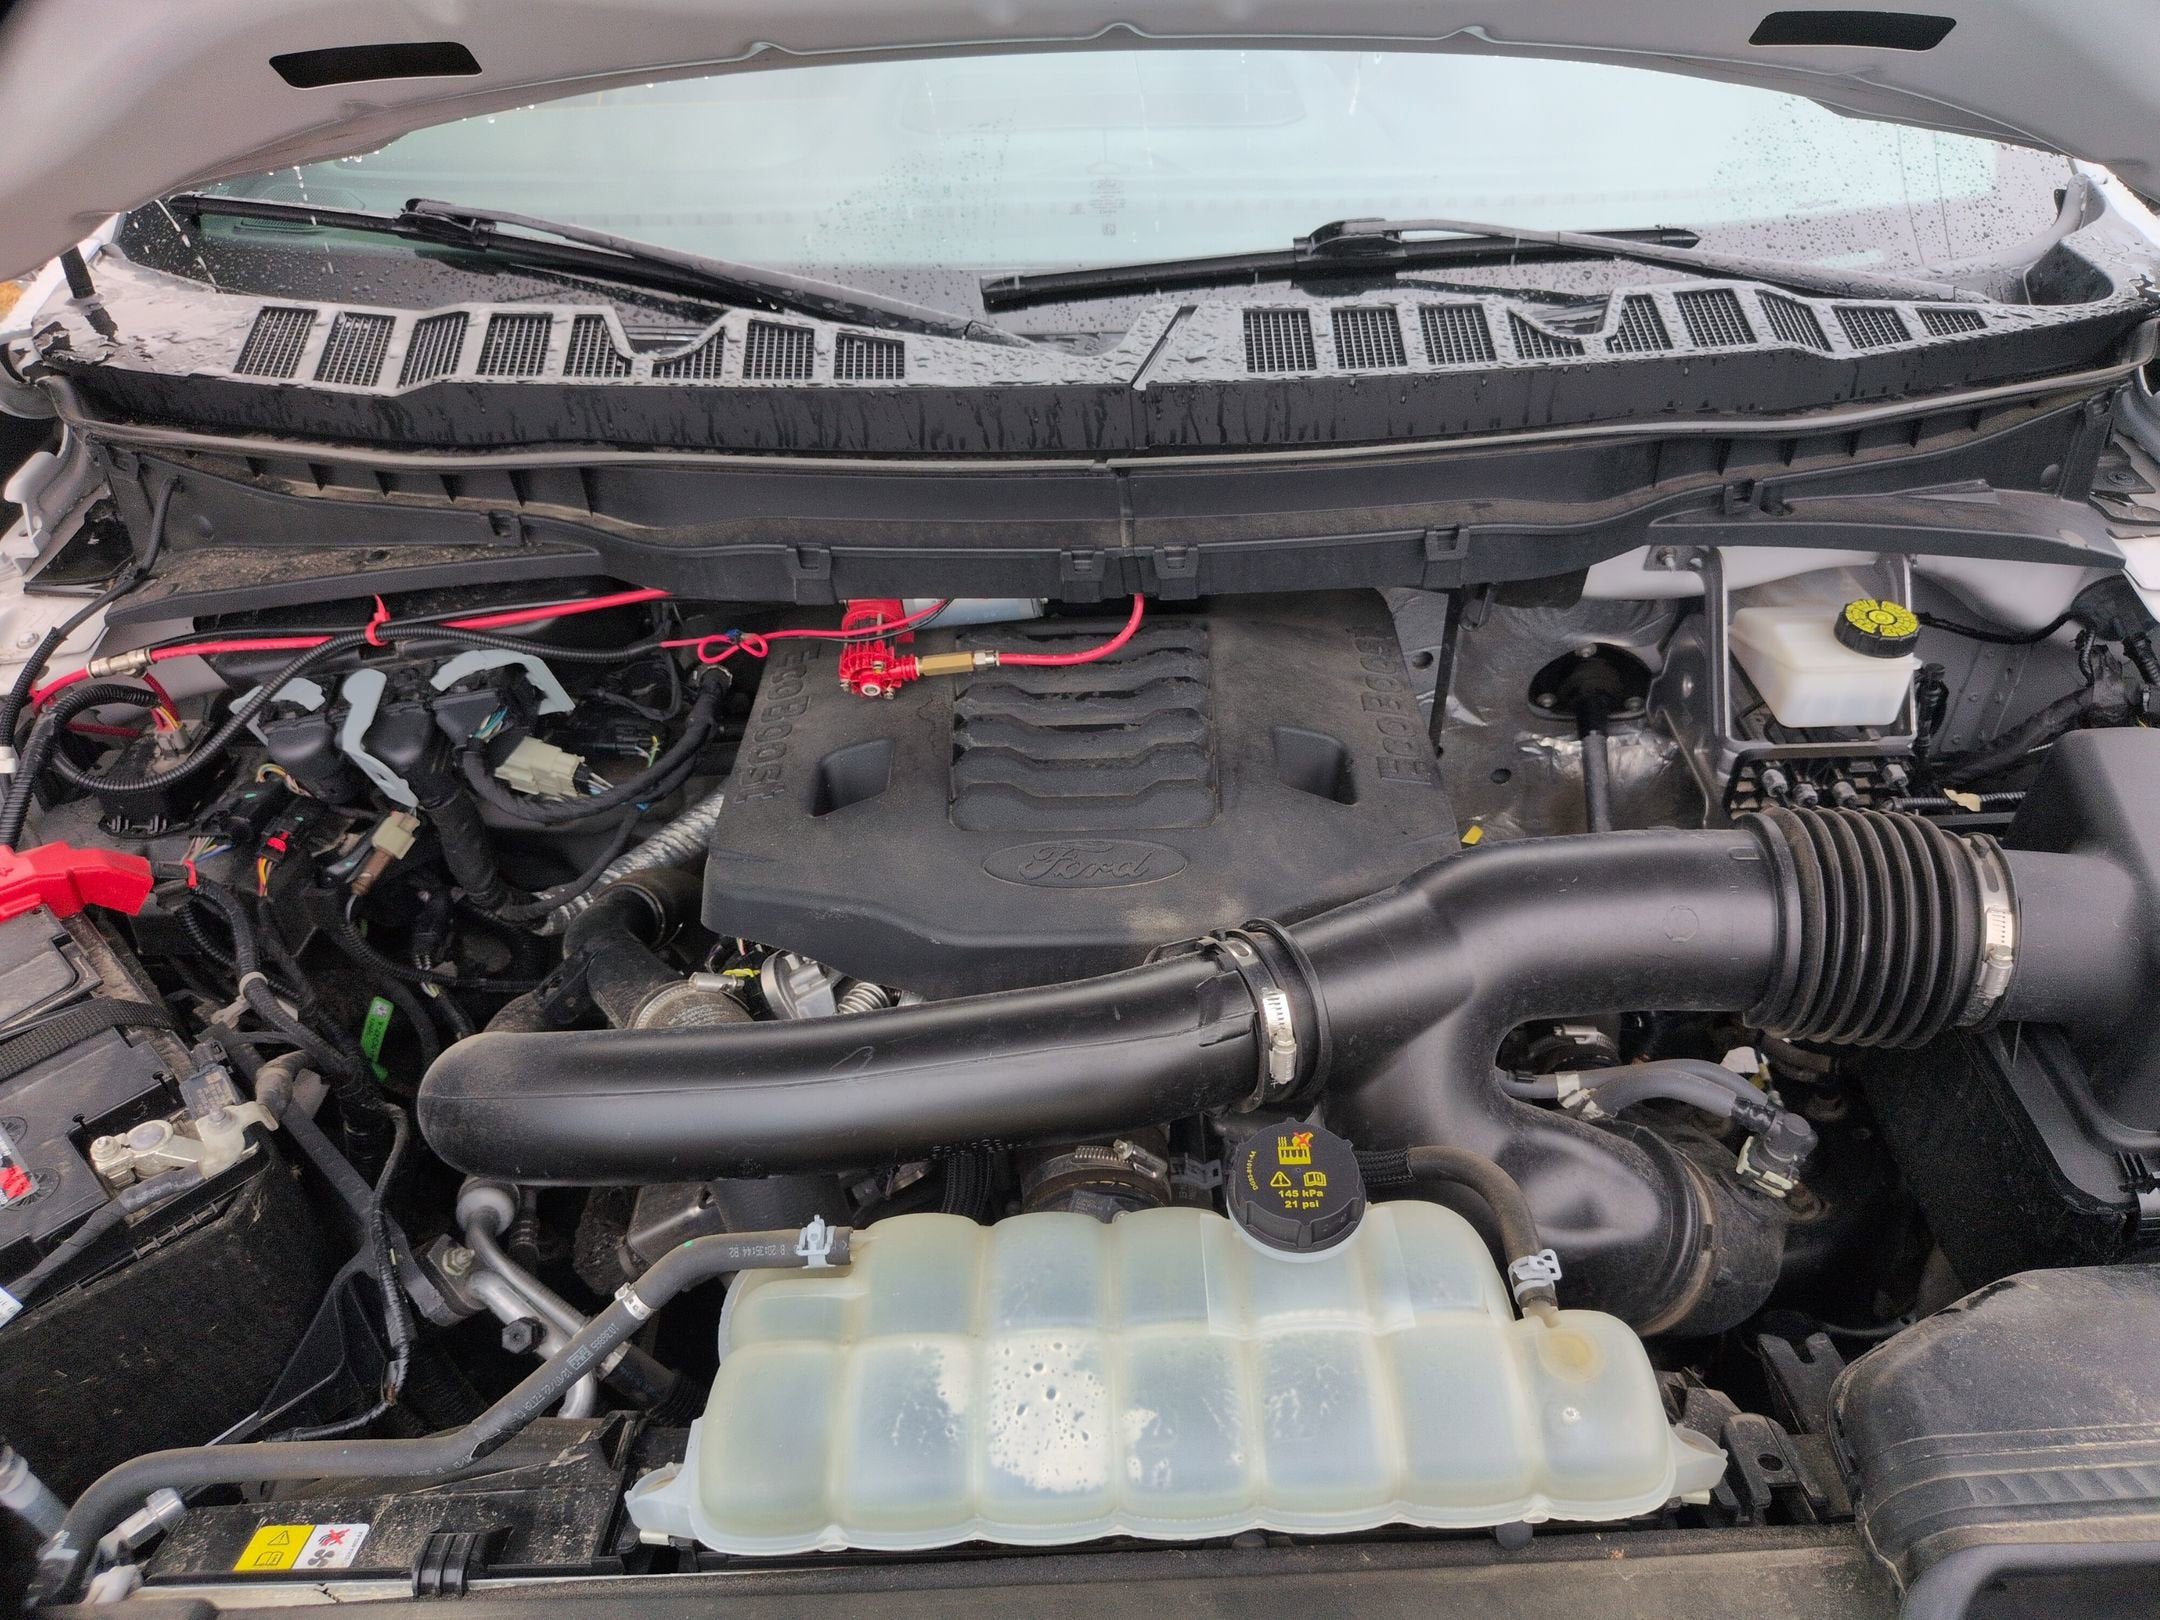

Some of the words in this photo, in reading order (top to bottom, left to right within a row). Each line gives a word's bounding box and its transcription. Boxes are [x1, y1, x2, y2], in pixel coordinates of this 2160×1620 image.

[1347, 627, 1433, 785] EcoBoos
[1018, 841, 1154, 880] Ford
[1278, 1189, 1299, 1198] 145
[1302, 1189, 1324, 1198] kPa
[1285, 1200, 1298, 1209] 21
[1302, 1199, 1319, 1210] psi
